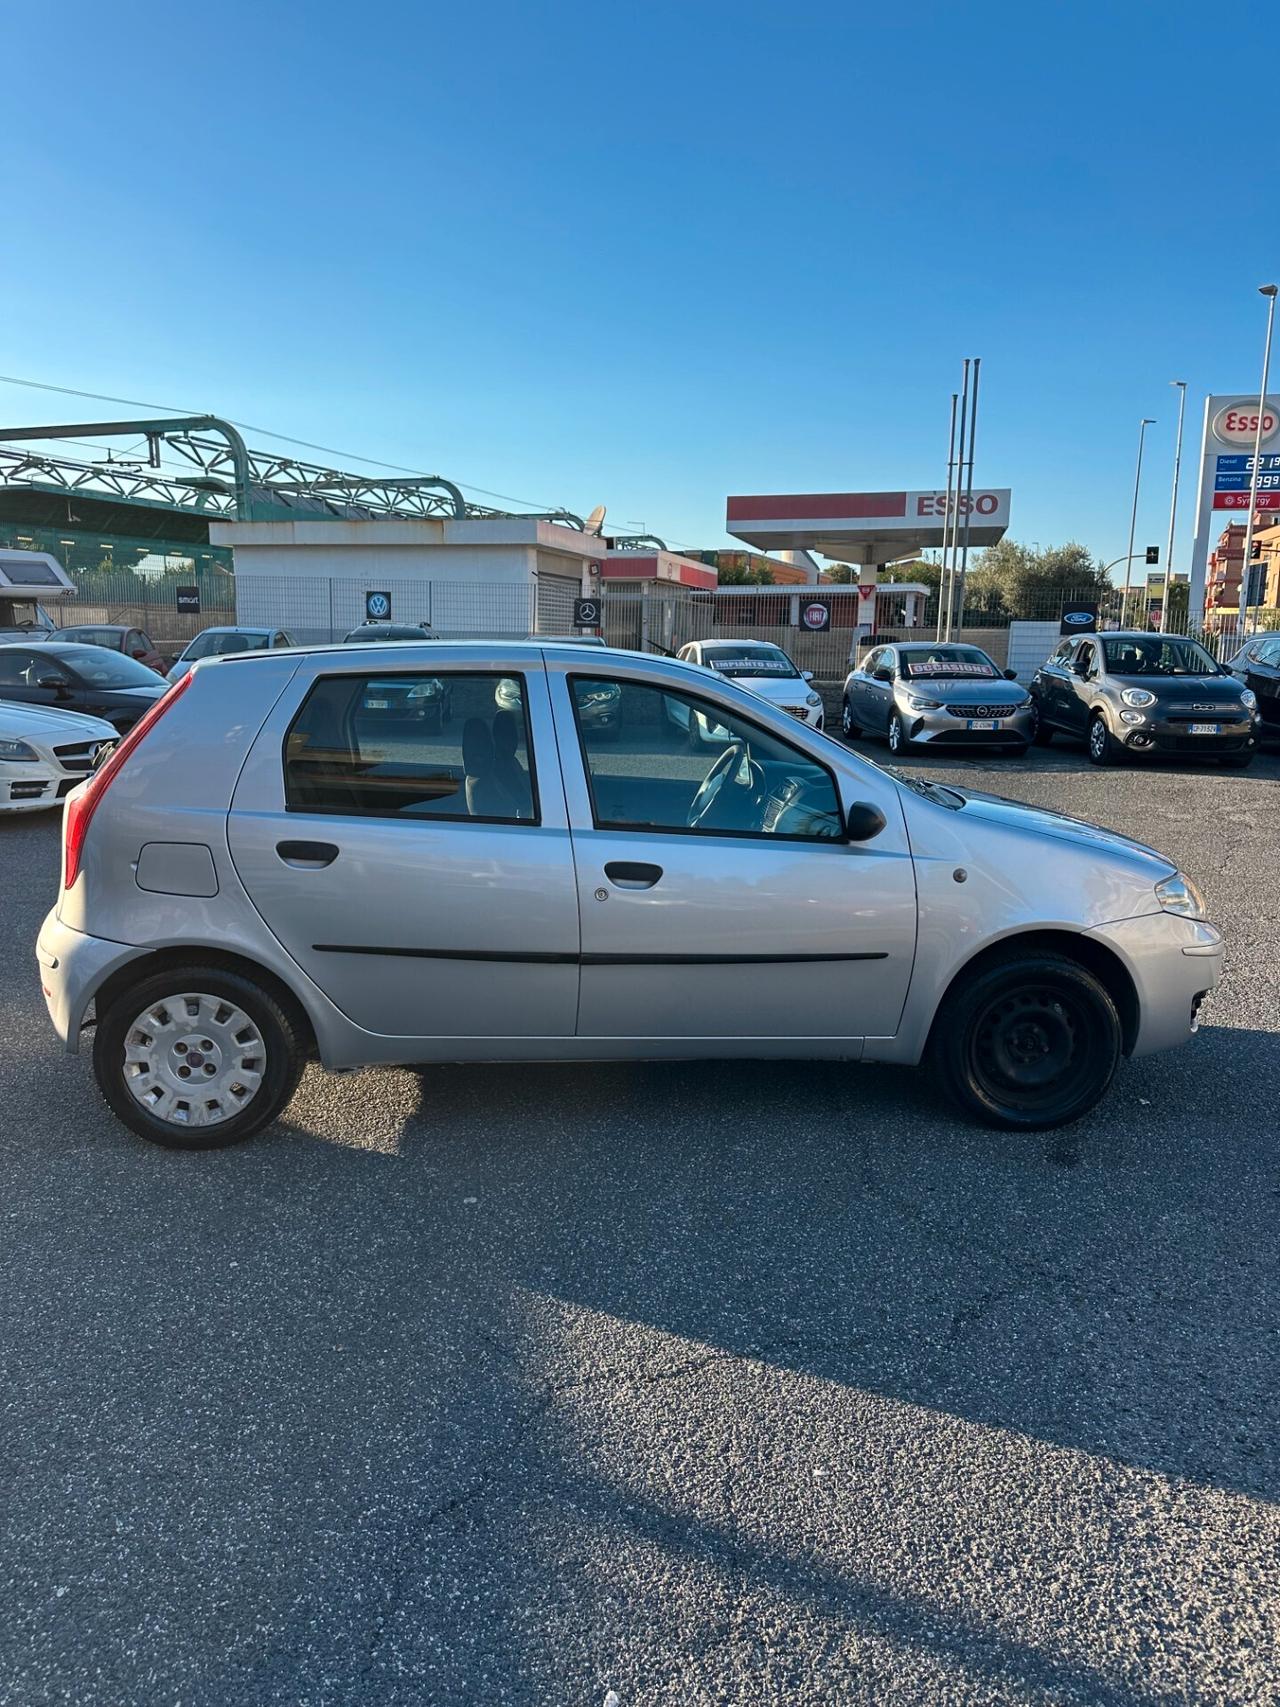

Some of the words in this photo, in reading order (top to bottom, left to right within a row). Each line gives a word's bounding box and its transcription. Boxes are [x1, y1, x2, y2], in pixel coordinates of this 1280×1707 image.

[917, 494, 998, 516] ESSO
[1236, 496, 1271, 506] Synrgy
[809, 610, 823, 622] FIAT
[914, 664, 991, 673] OCCASIONE
